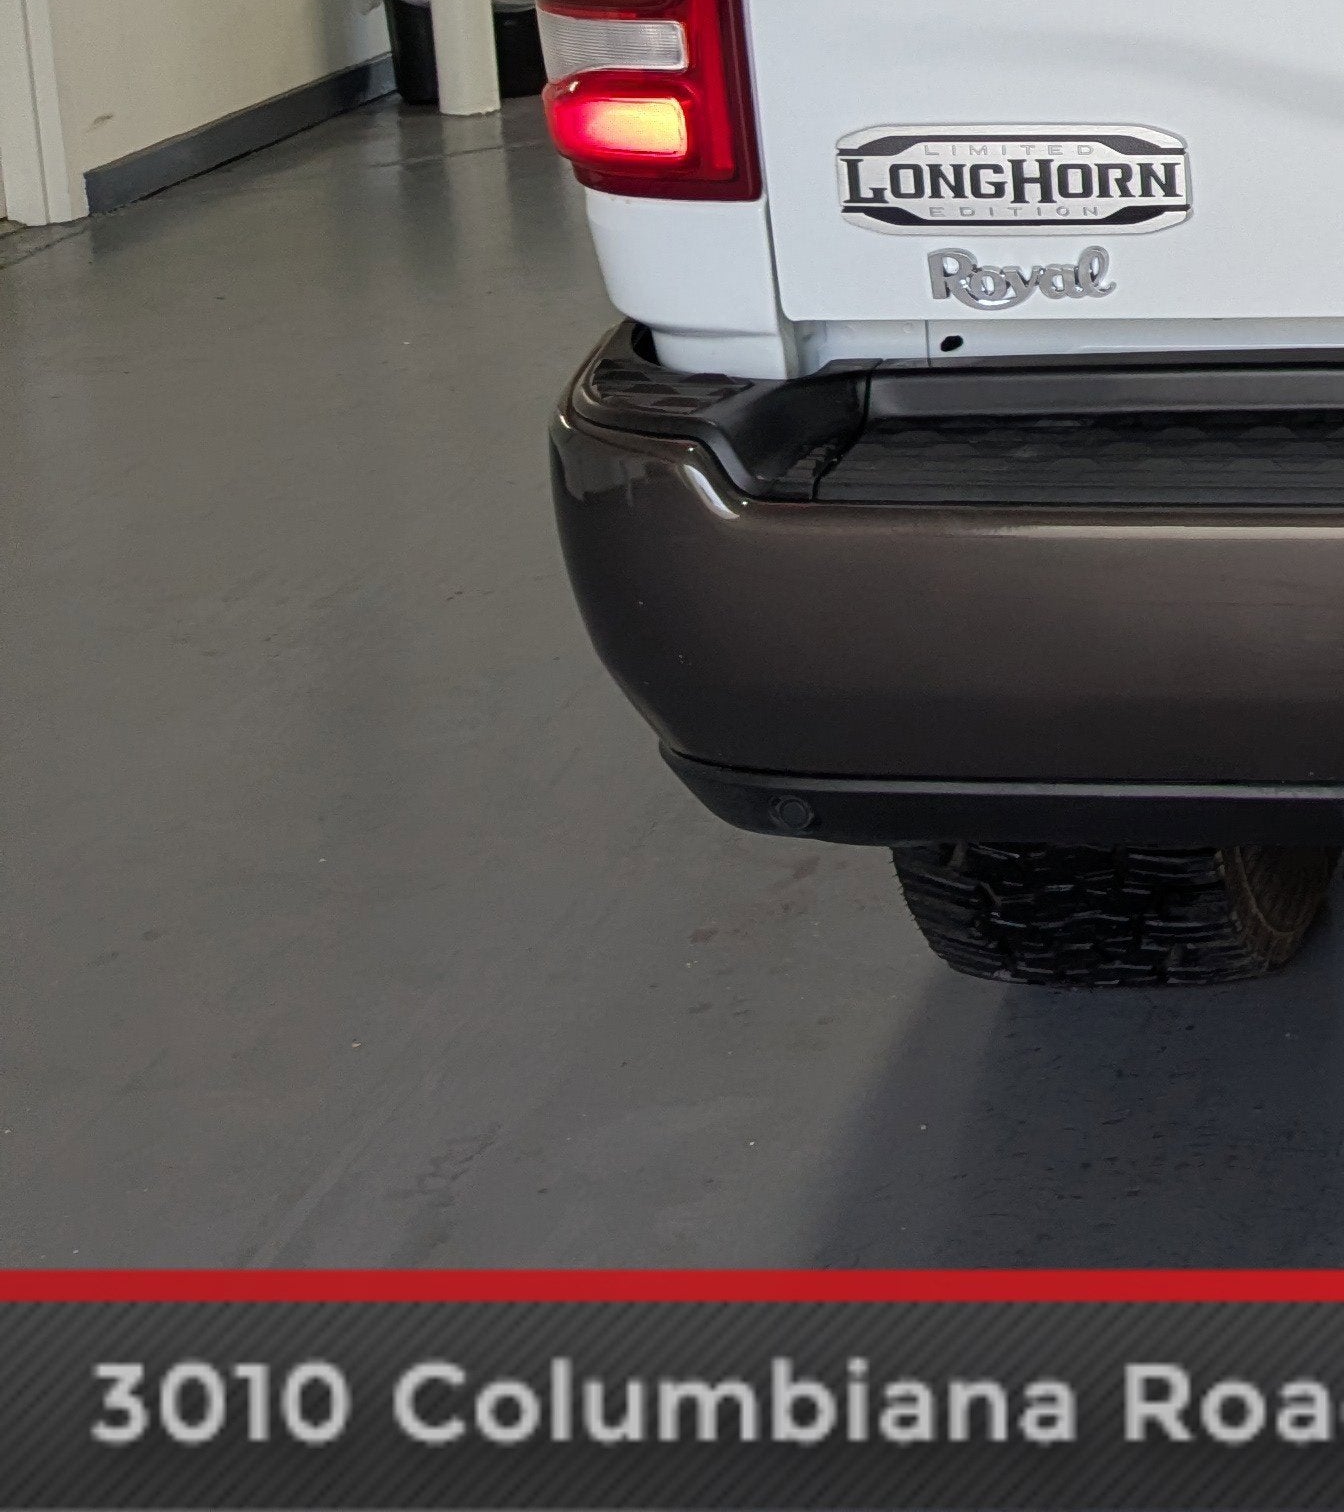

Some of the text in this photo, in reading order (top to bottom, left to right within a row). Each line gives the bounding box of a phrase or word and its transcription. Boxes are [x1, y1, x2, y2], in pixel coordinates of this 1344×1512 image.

[923, 144, 1094, 157] LIMITED
[840, 158, 1182, 205] LONGHORN
[928, 206, 1100, 218] EDITION
[926, 245, 1117, 311] Royal
